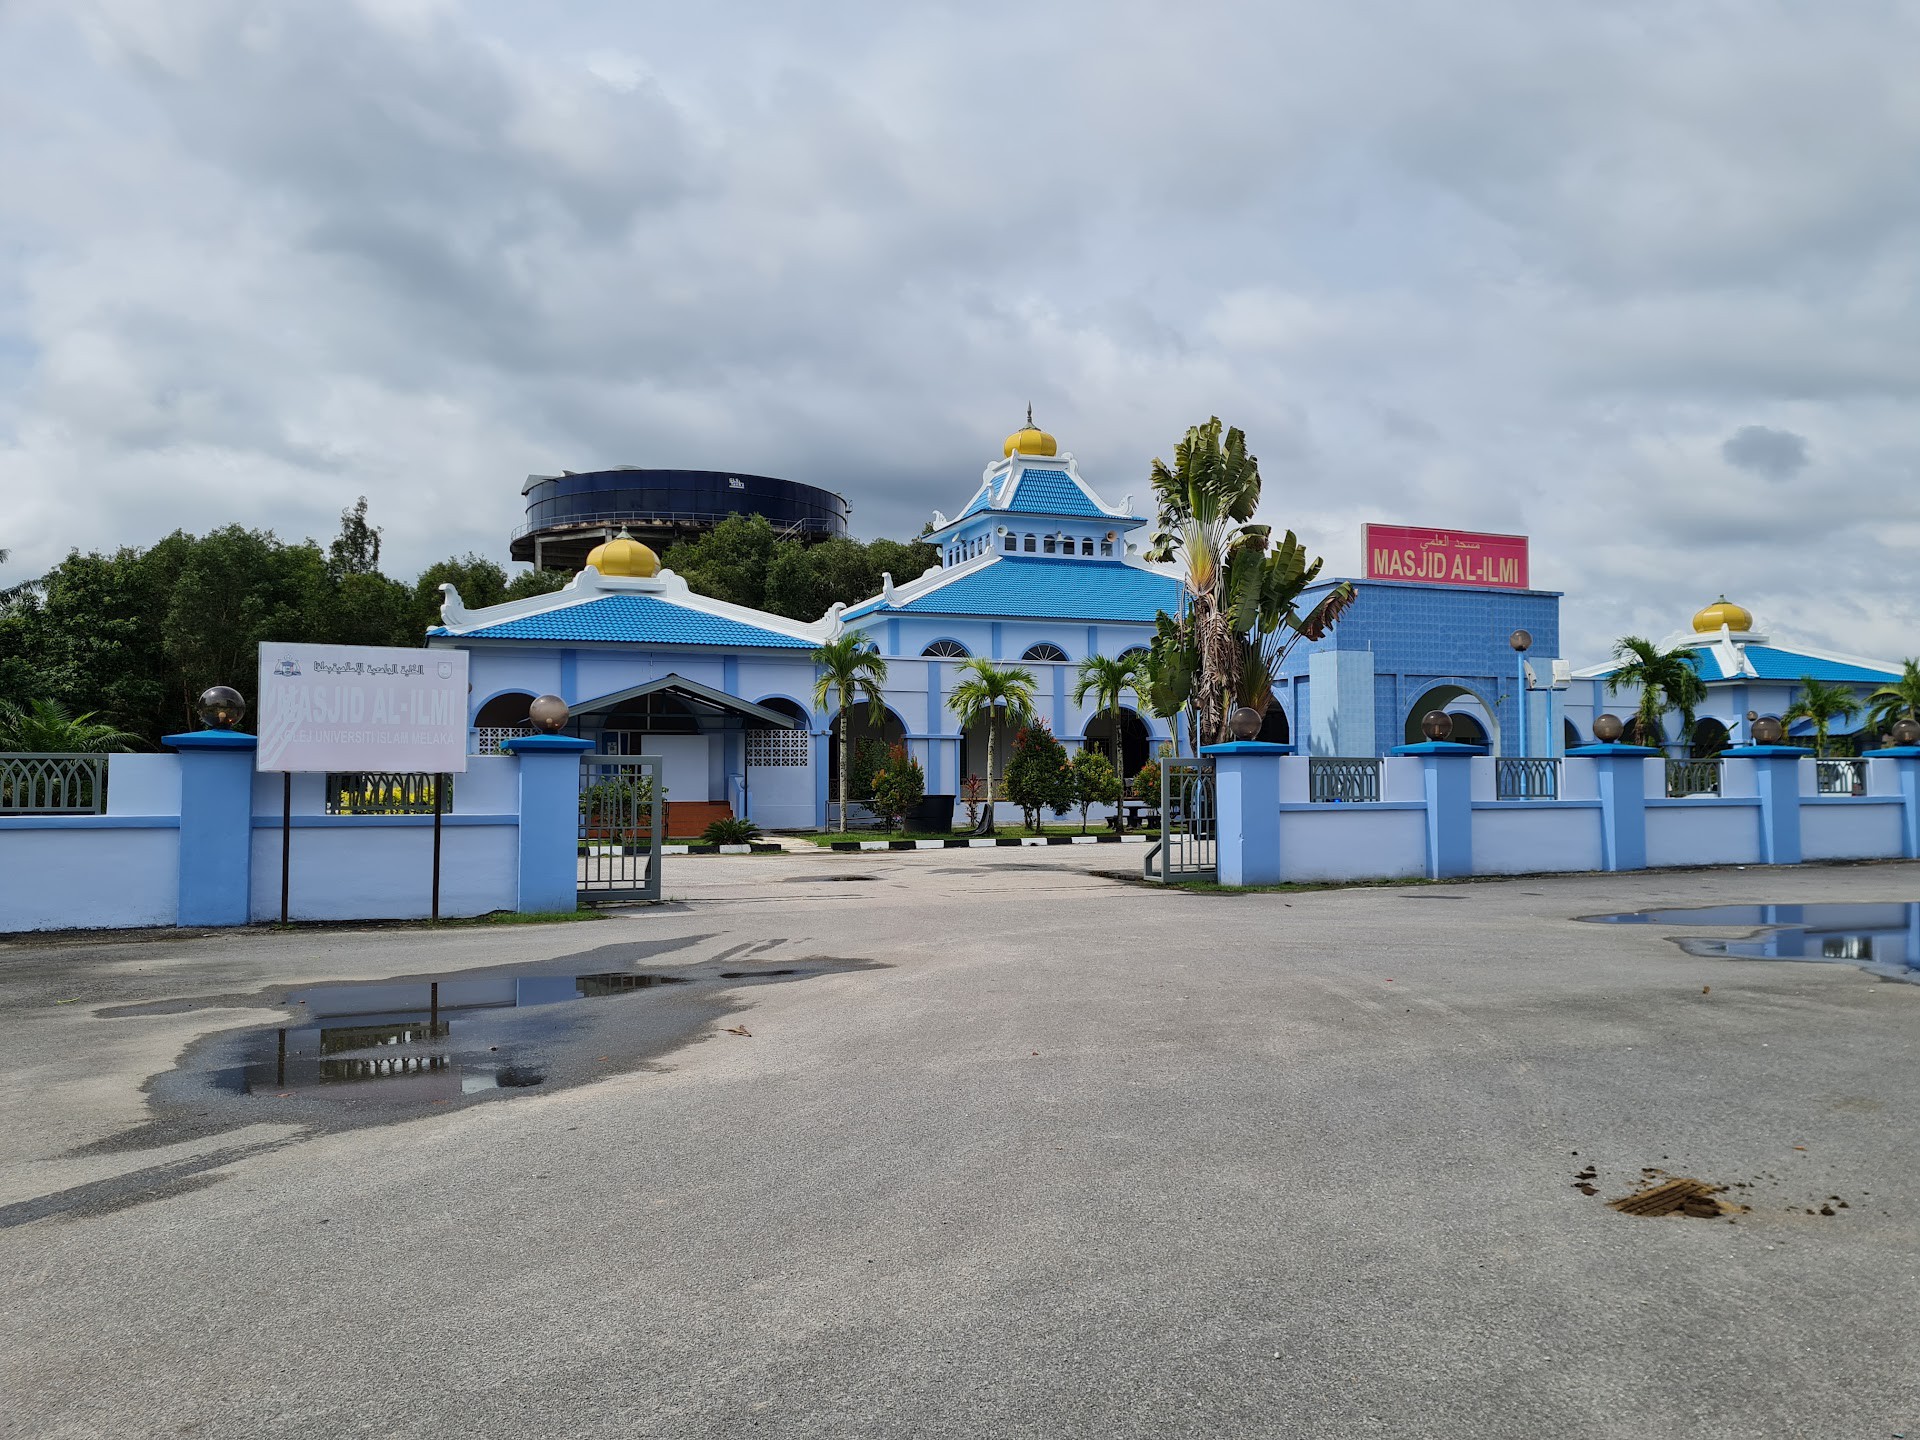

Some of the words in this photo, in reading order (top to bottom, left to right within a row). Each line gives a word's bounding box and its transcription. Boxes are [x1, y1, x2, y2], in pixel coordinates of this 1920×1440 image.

[1373, 548, 1447, 578] MASJID
[1450, 553, 1519, 584] AL-ILMI
[278, 685, 365, 724] MASJID
[372, 687, 456, 726] AL-ILMI
[315, 730, 375, 744] UNIVERSITI
[377, 731, 409, 745] ISLAM
[411, 732, 455, 745] MELAKA
